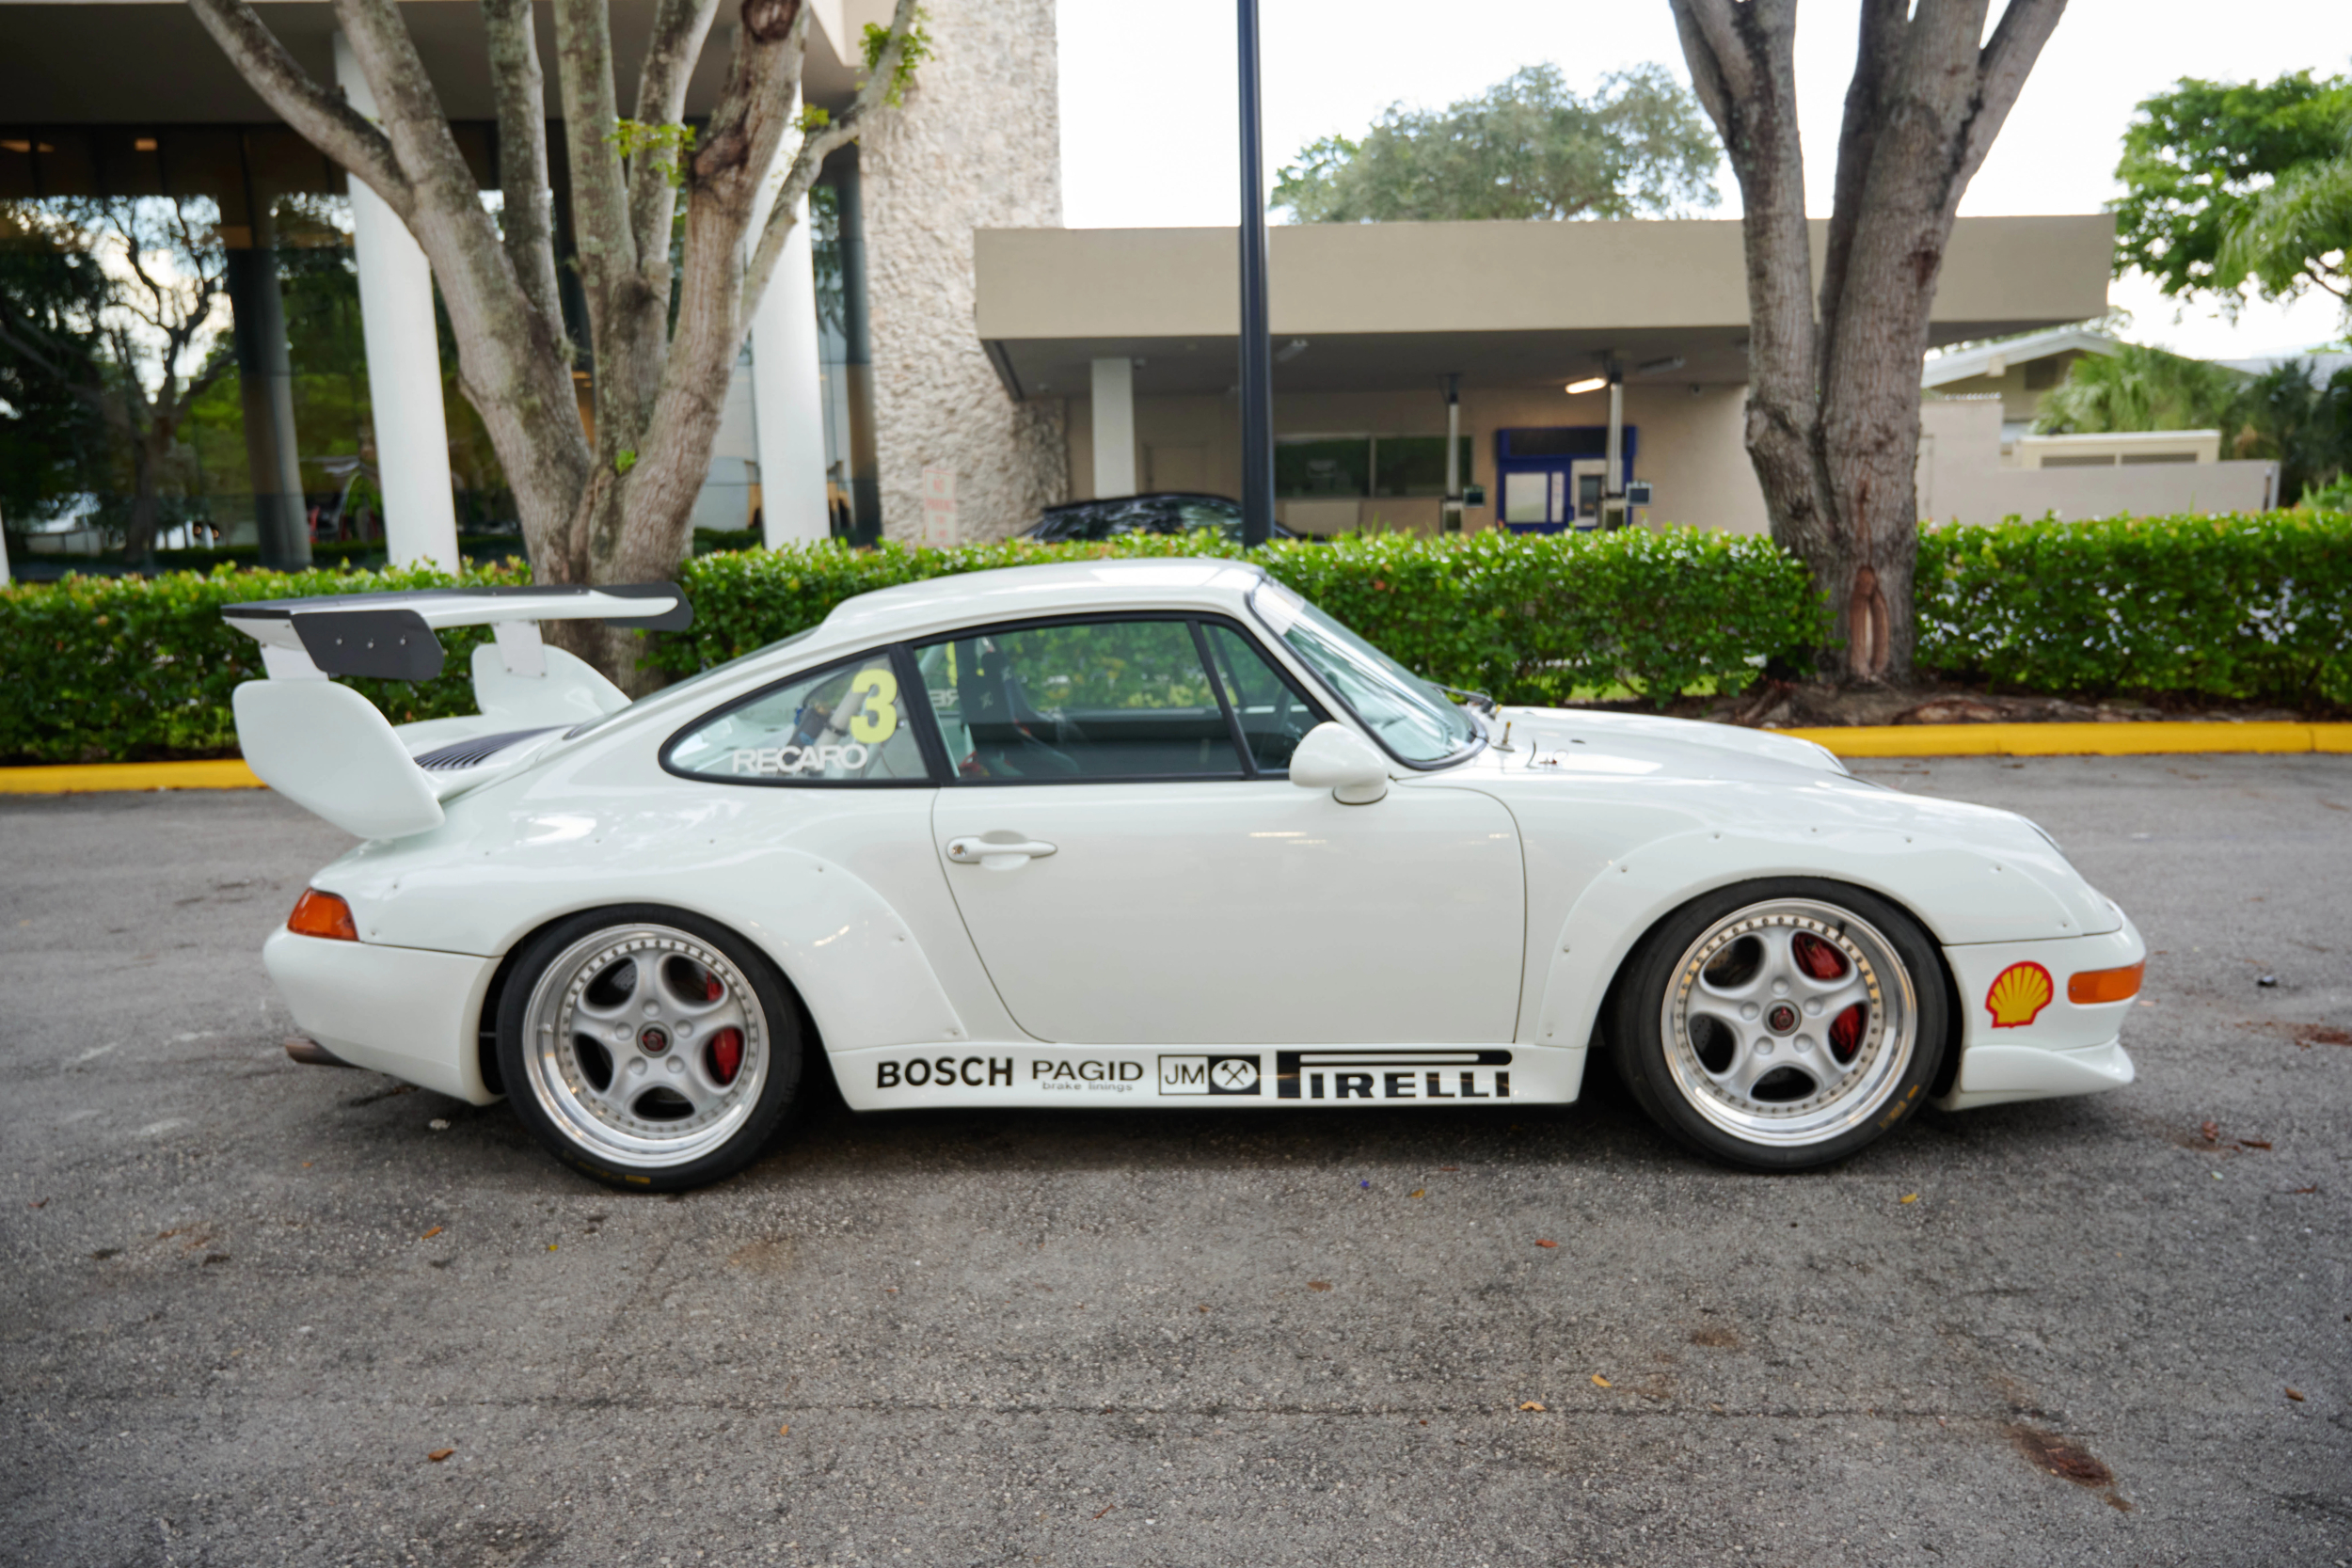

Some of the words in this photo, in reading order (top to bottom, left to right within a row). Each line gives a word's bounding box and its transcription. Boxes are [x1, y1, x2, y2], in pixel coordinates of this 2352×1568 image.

[850, 668, 897, 744] 3
[732, 743, 868, 774] RECARO
[877, 1055, 1013, 1088] BOSCH
[1032, 1060, 1144, 1082] PAGID
[1164, 1063, 1205, 1085] JM
[1277, 1050, 1513, 1099] PIRELLI
[1042, 1081, 1082, 1091] brake
[1089, 1081, 1134, 1093] linings
